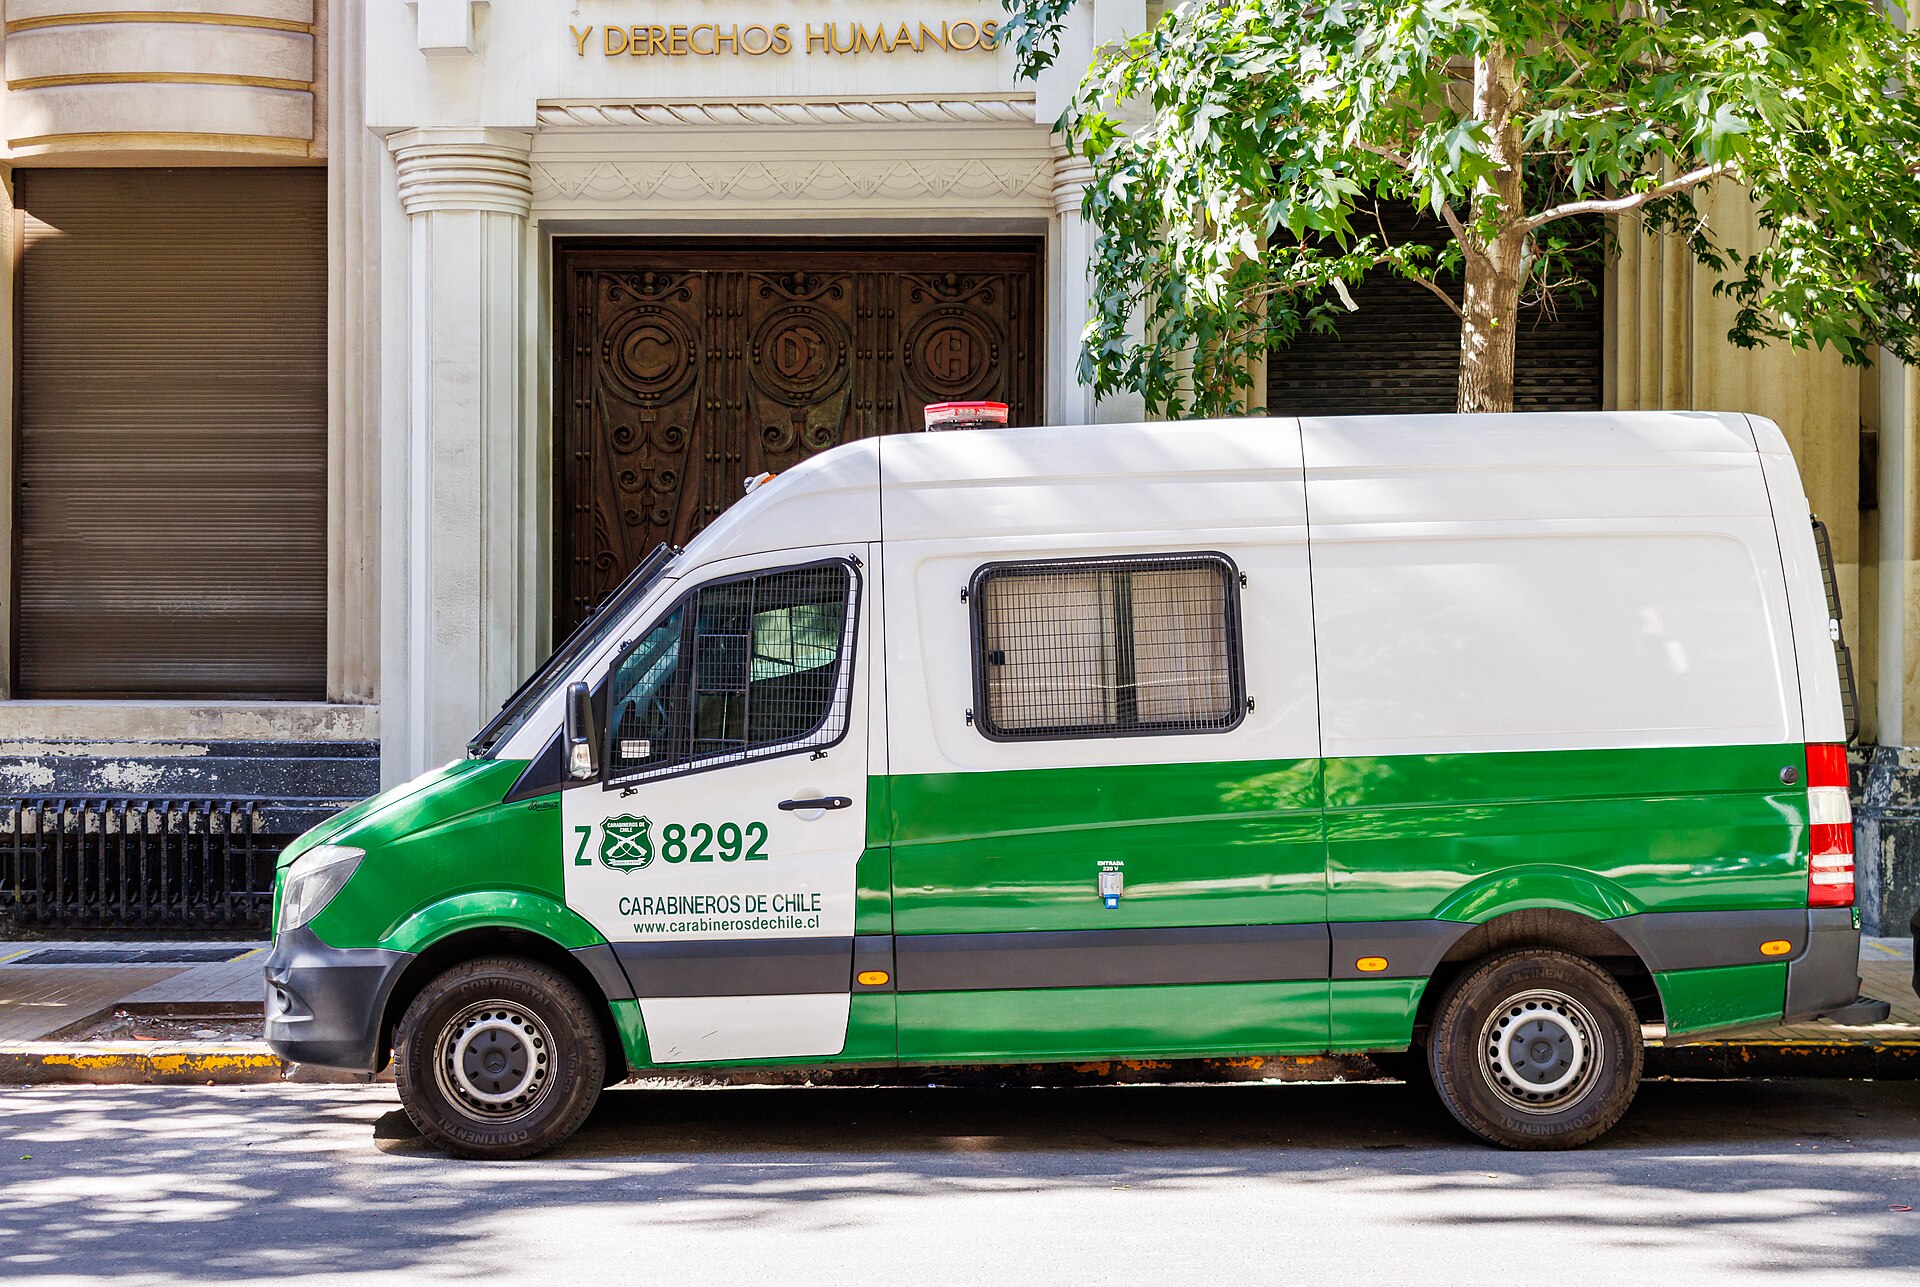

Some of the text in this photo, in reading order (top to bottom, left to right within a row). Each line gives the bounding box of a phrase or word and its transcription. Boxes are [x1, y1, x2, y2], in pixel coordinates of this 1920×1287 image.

[569, 20, 1000, 57] Y DERECHOS HUMANOS
[574, 821, 769, 867] Z 8292
[618, 893, 822, 916] CARABINEROS DE CHILE
[633, 914, 820, 934] www.carabinerosdechile.cl
[459, 977, 552, 1008] CONTINENTAL
[562, 1051, 578, 1094] Vanco
[436, 1114, 529, 1146] CONTINENTAL
[1499, 1113, 1593, 1136] CONTINENTAL
